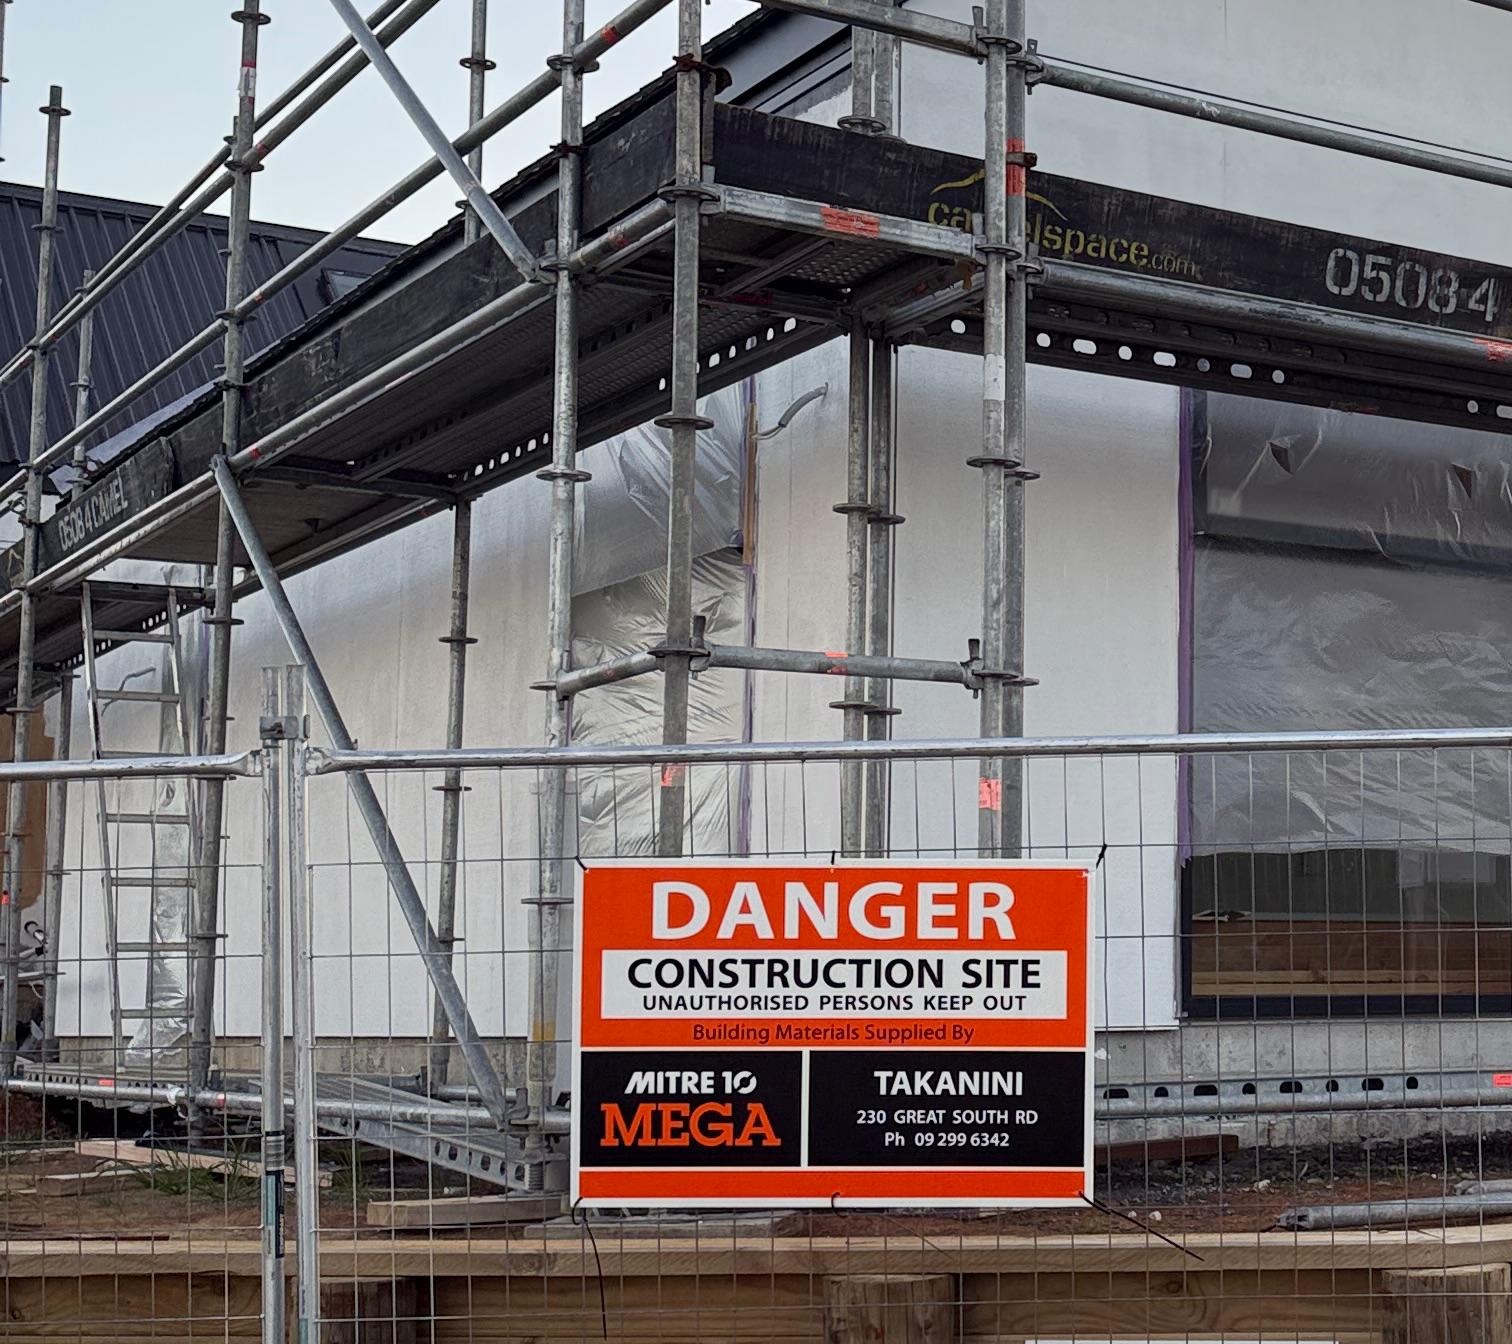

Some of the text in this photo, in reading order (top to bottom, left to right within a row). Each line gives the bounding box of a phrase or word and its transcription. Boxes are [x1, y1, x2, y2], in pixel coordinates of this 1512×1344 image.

[651, 880, 1017, 941] DANGER
[627, 958, 1041, 990] CONSTRUCTION SITE
[643, 994, 1027, 1012] UNAUTHORISED PERSONS KEEP OUT
[692, 1023, 975, 1044] Building Materials Supplied By
[624, 1070, 758, 1094] MITRE 10
[873, 1071, 1024, 1096] TAKANINI
[600, 1102, 782, 1147] MEGA
[856, 1109, 1039, 1124] 230 GREAT SOUTH RD
[884, 1131, 1010, 1147] Ph 09 299 6342
